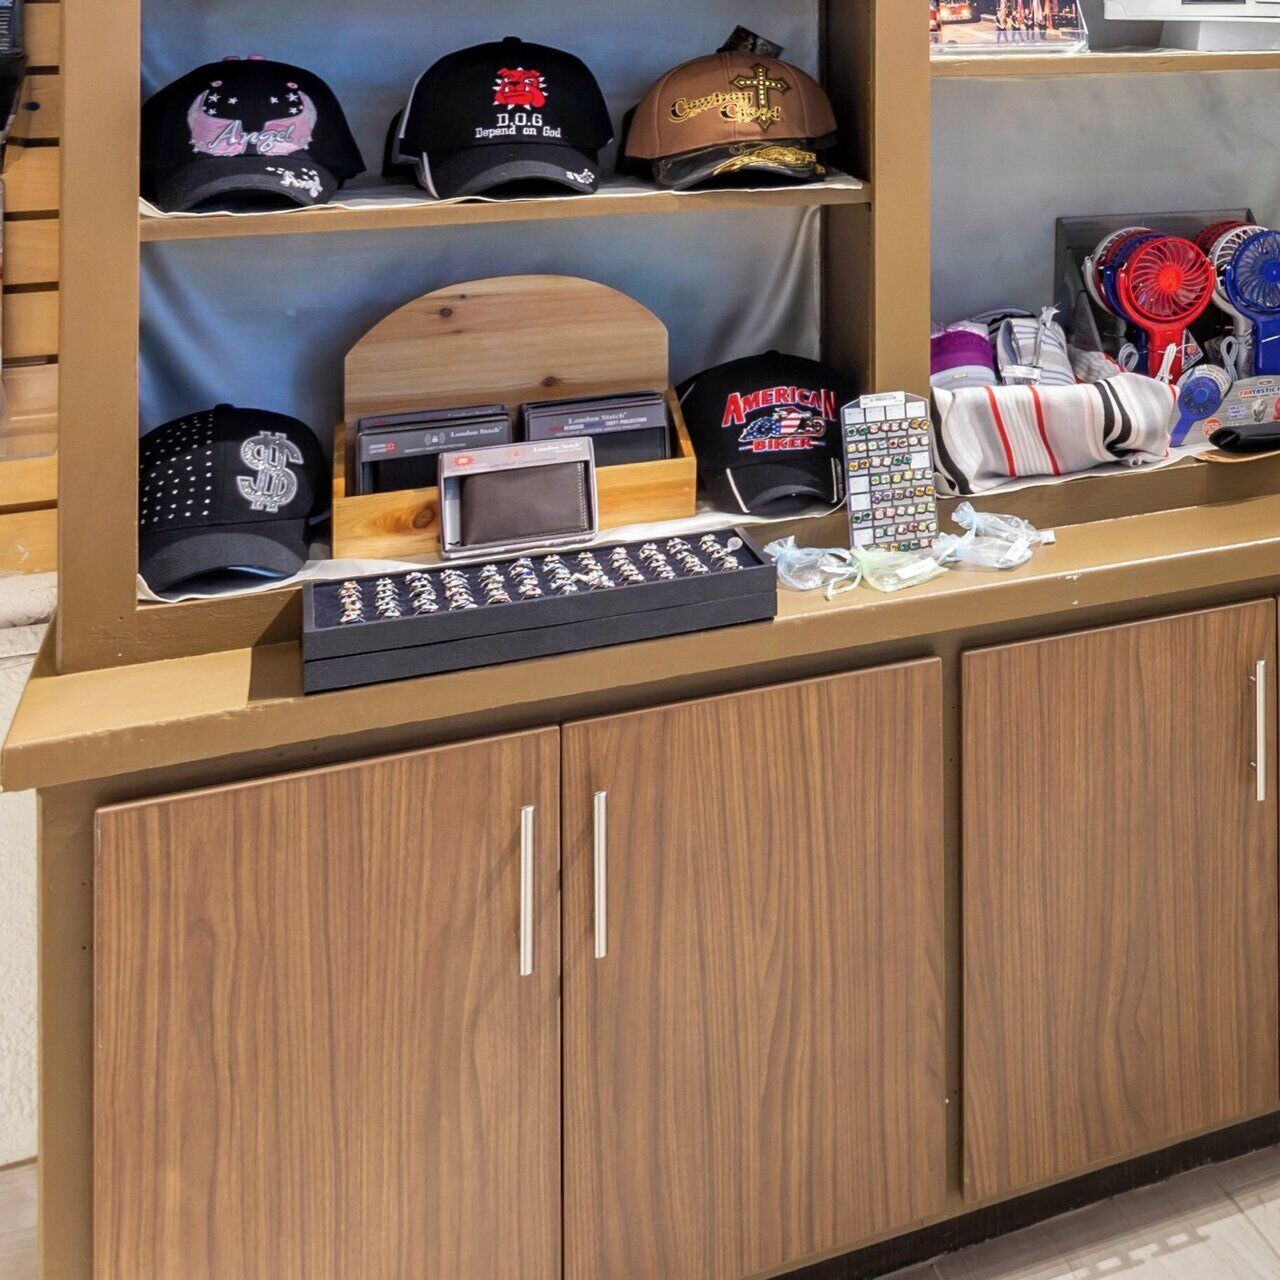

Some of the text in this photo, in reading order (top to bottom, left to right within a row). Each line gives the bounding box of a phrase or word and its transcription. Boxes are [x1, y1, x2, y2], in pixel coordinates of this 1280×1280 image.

[208, 119, 295, 152] Angel
[475, 125, 561, 138] Depend on God
[721, 386, 837, 427] AMERICAN
[753, 436, 813, 453] BIKER
